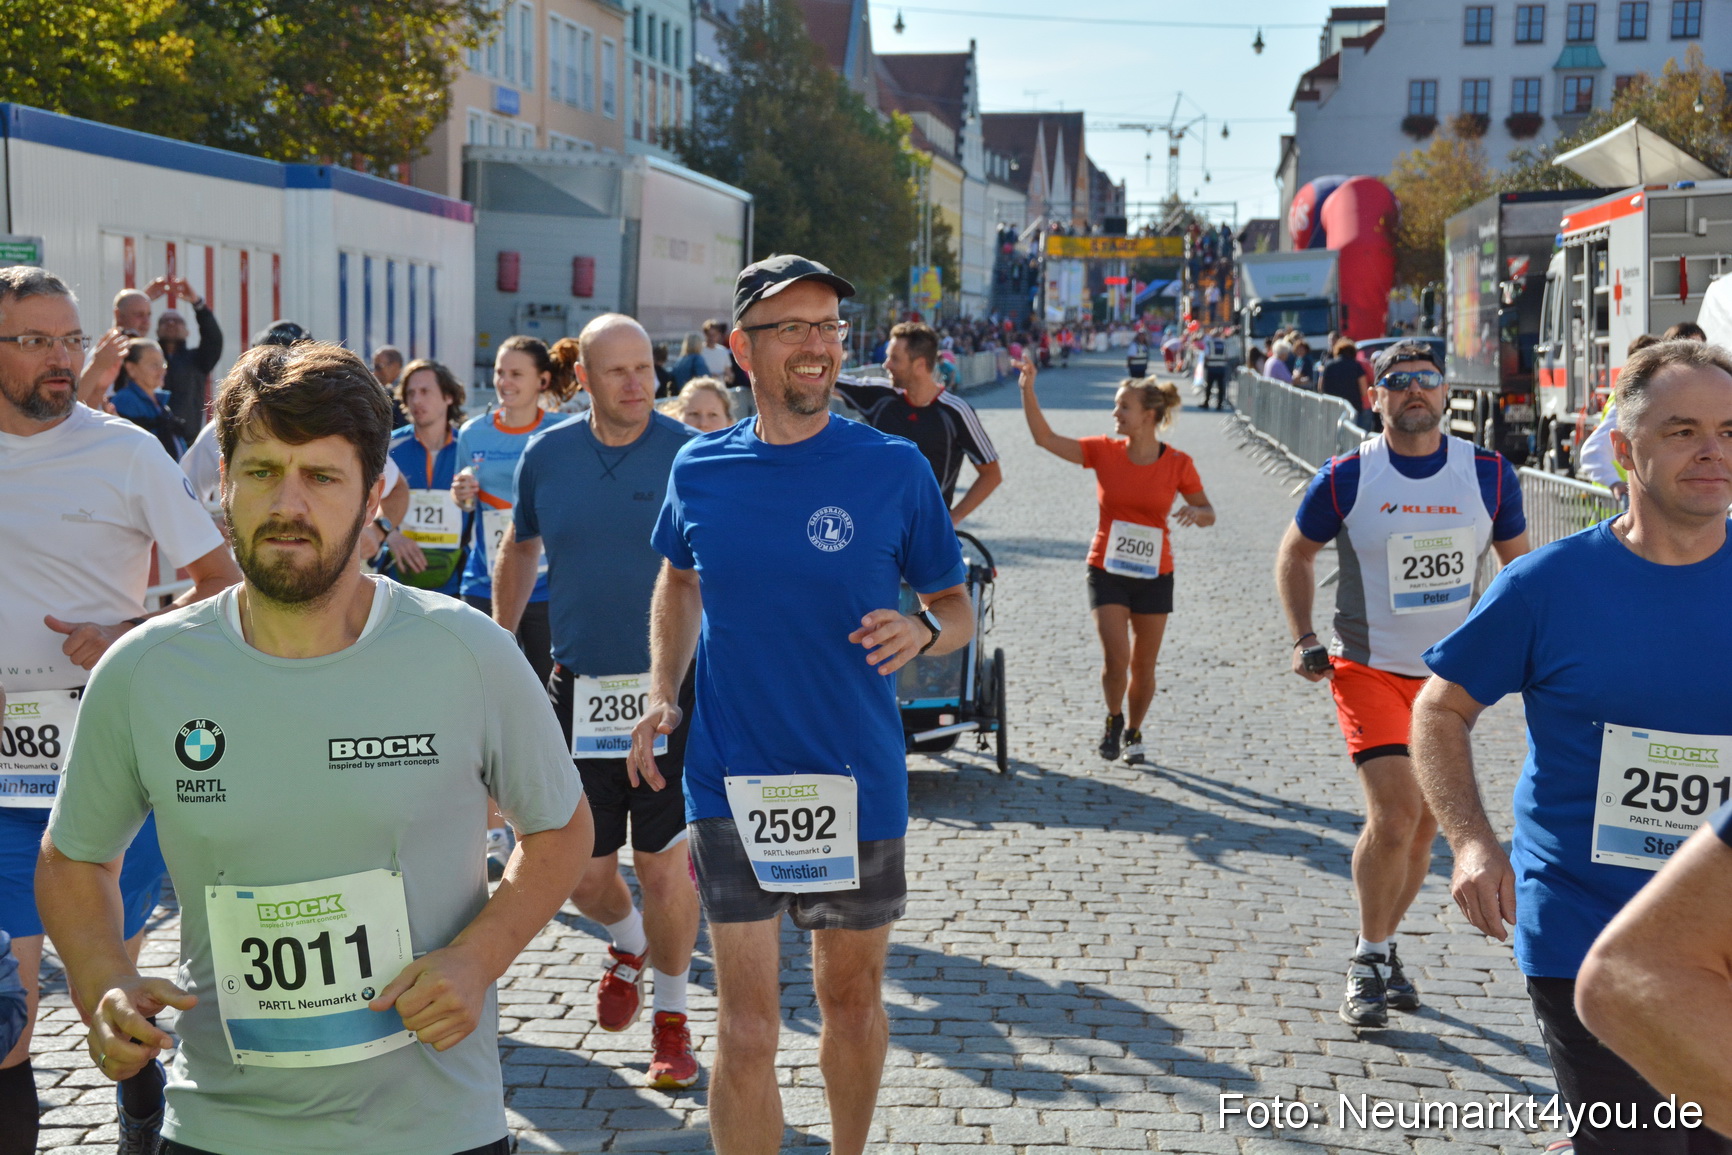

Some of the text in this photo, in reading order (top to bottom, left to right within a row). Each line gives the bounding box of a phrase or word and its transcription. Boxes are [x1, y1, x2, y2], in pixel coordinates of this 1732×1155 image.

[414, 507, 443, 524] 121
[1402, 505, 1463, 514] KLEBL
[810, 535, 847, 551] NEUMARKT
[1116, 536, 1154, 557] 2509
[1402, 551, 1464, 580] 2363
[1423, 593, 1449, 604] Peter
[180, 720, 222, 737] BMW
[329, 733, 438, 761] BOCK
[1648, 743, 1719, 763] BOCK
[329, 758, 439, 770] inspired by smart concepts
[176, 779, 226, 792] PARTL
[763, 785, 818, 798] BOCK
[1621, 767, 1731, 816] 2591
[177, 793, 226, 803] Neumarkt
[748, 806, 837, 843] 2592
[1630, 815, 1701, 831] PARTL Neuma
[786, 847, 820, 856] Neumarkt
[771, 864, 827, 880] Christian
[257, 894, 345, 921] BOCK
[296, 917, 316, 925] smart
[317, 913, 347, 922] concepts
[241, 924, 373, 991] 3011
[228, 980, 234, 990] C
[259, 1000, 295, 1010] PARTL
[298, 993, 357, 1009] Neumarkt
